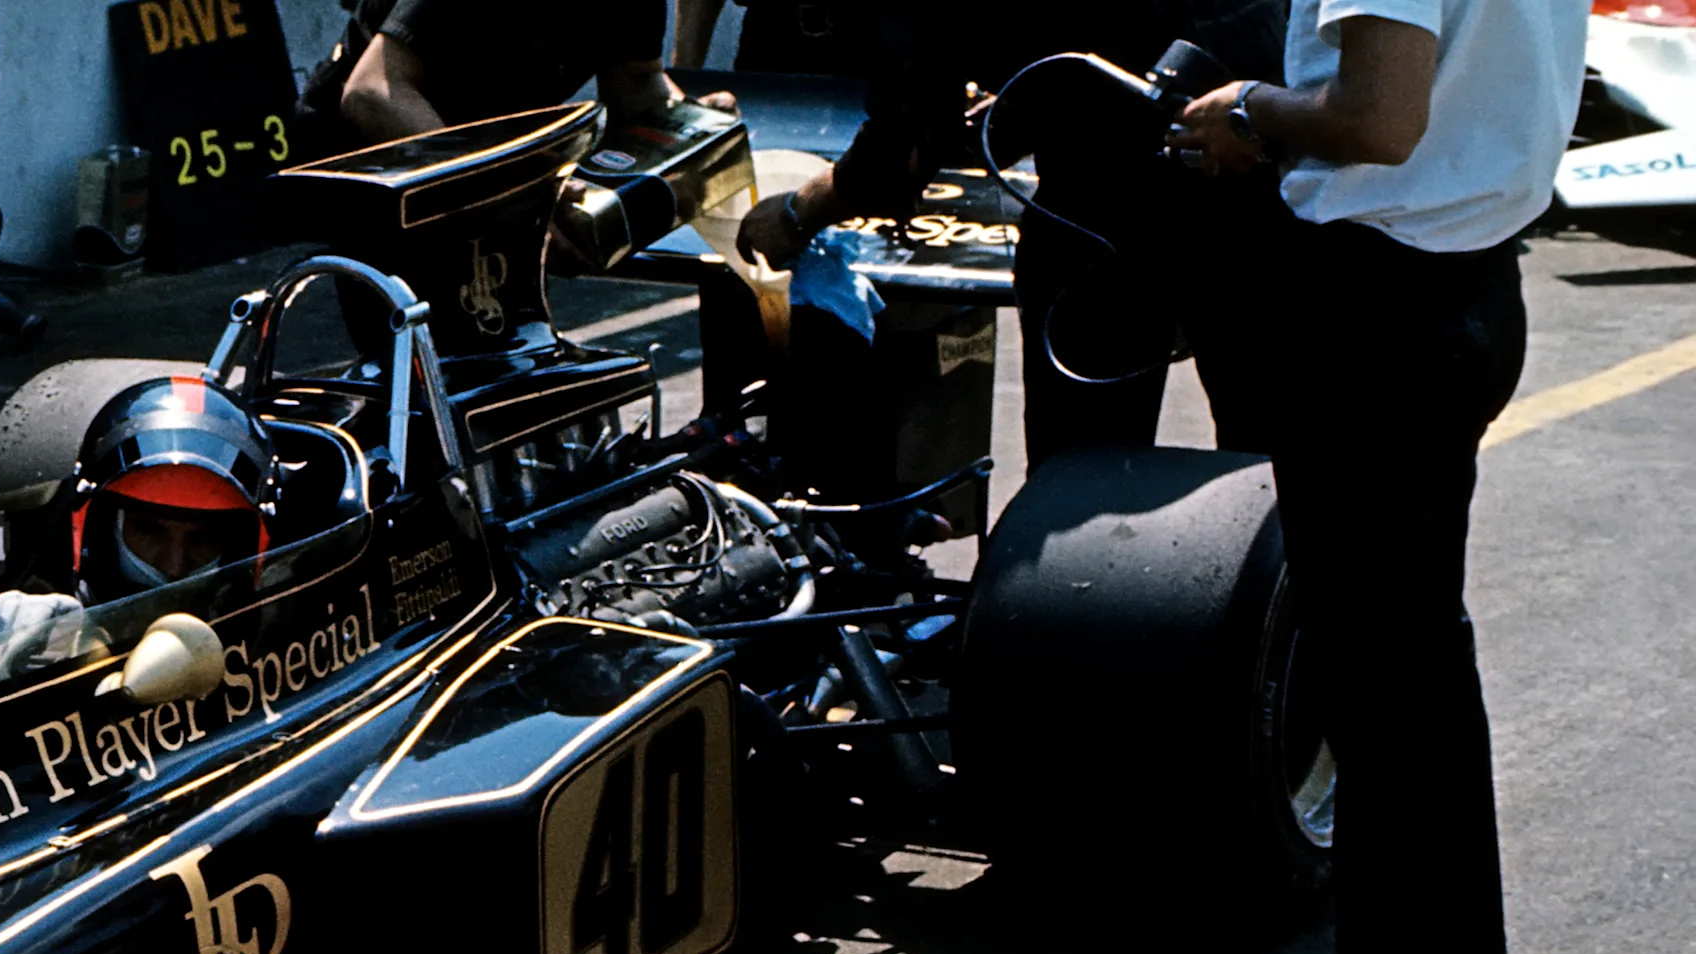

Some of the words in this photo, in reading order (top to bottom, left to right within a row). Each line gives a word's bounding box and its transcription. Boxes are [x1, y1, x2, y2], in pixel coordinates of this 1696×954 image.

[137, 0, 249, 56] DAVE
[169, 114, 290, 187] 25-3
[600, 516, 649, 545] FORD
[388, 540, 453, 587] Emerson
[223, 583, 381, 724] Special
